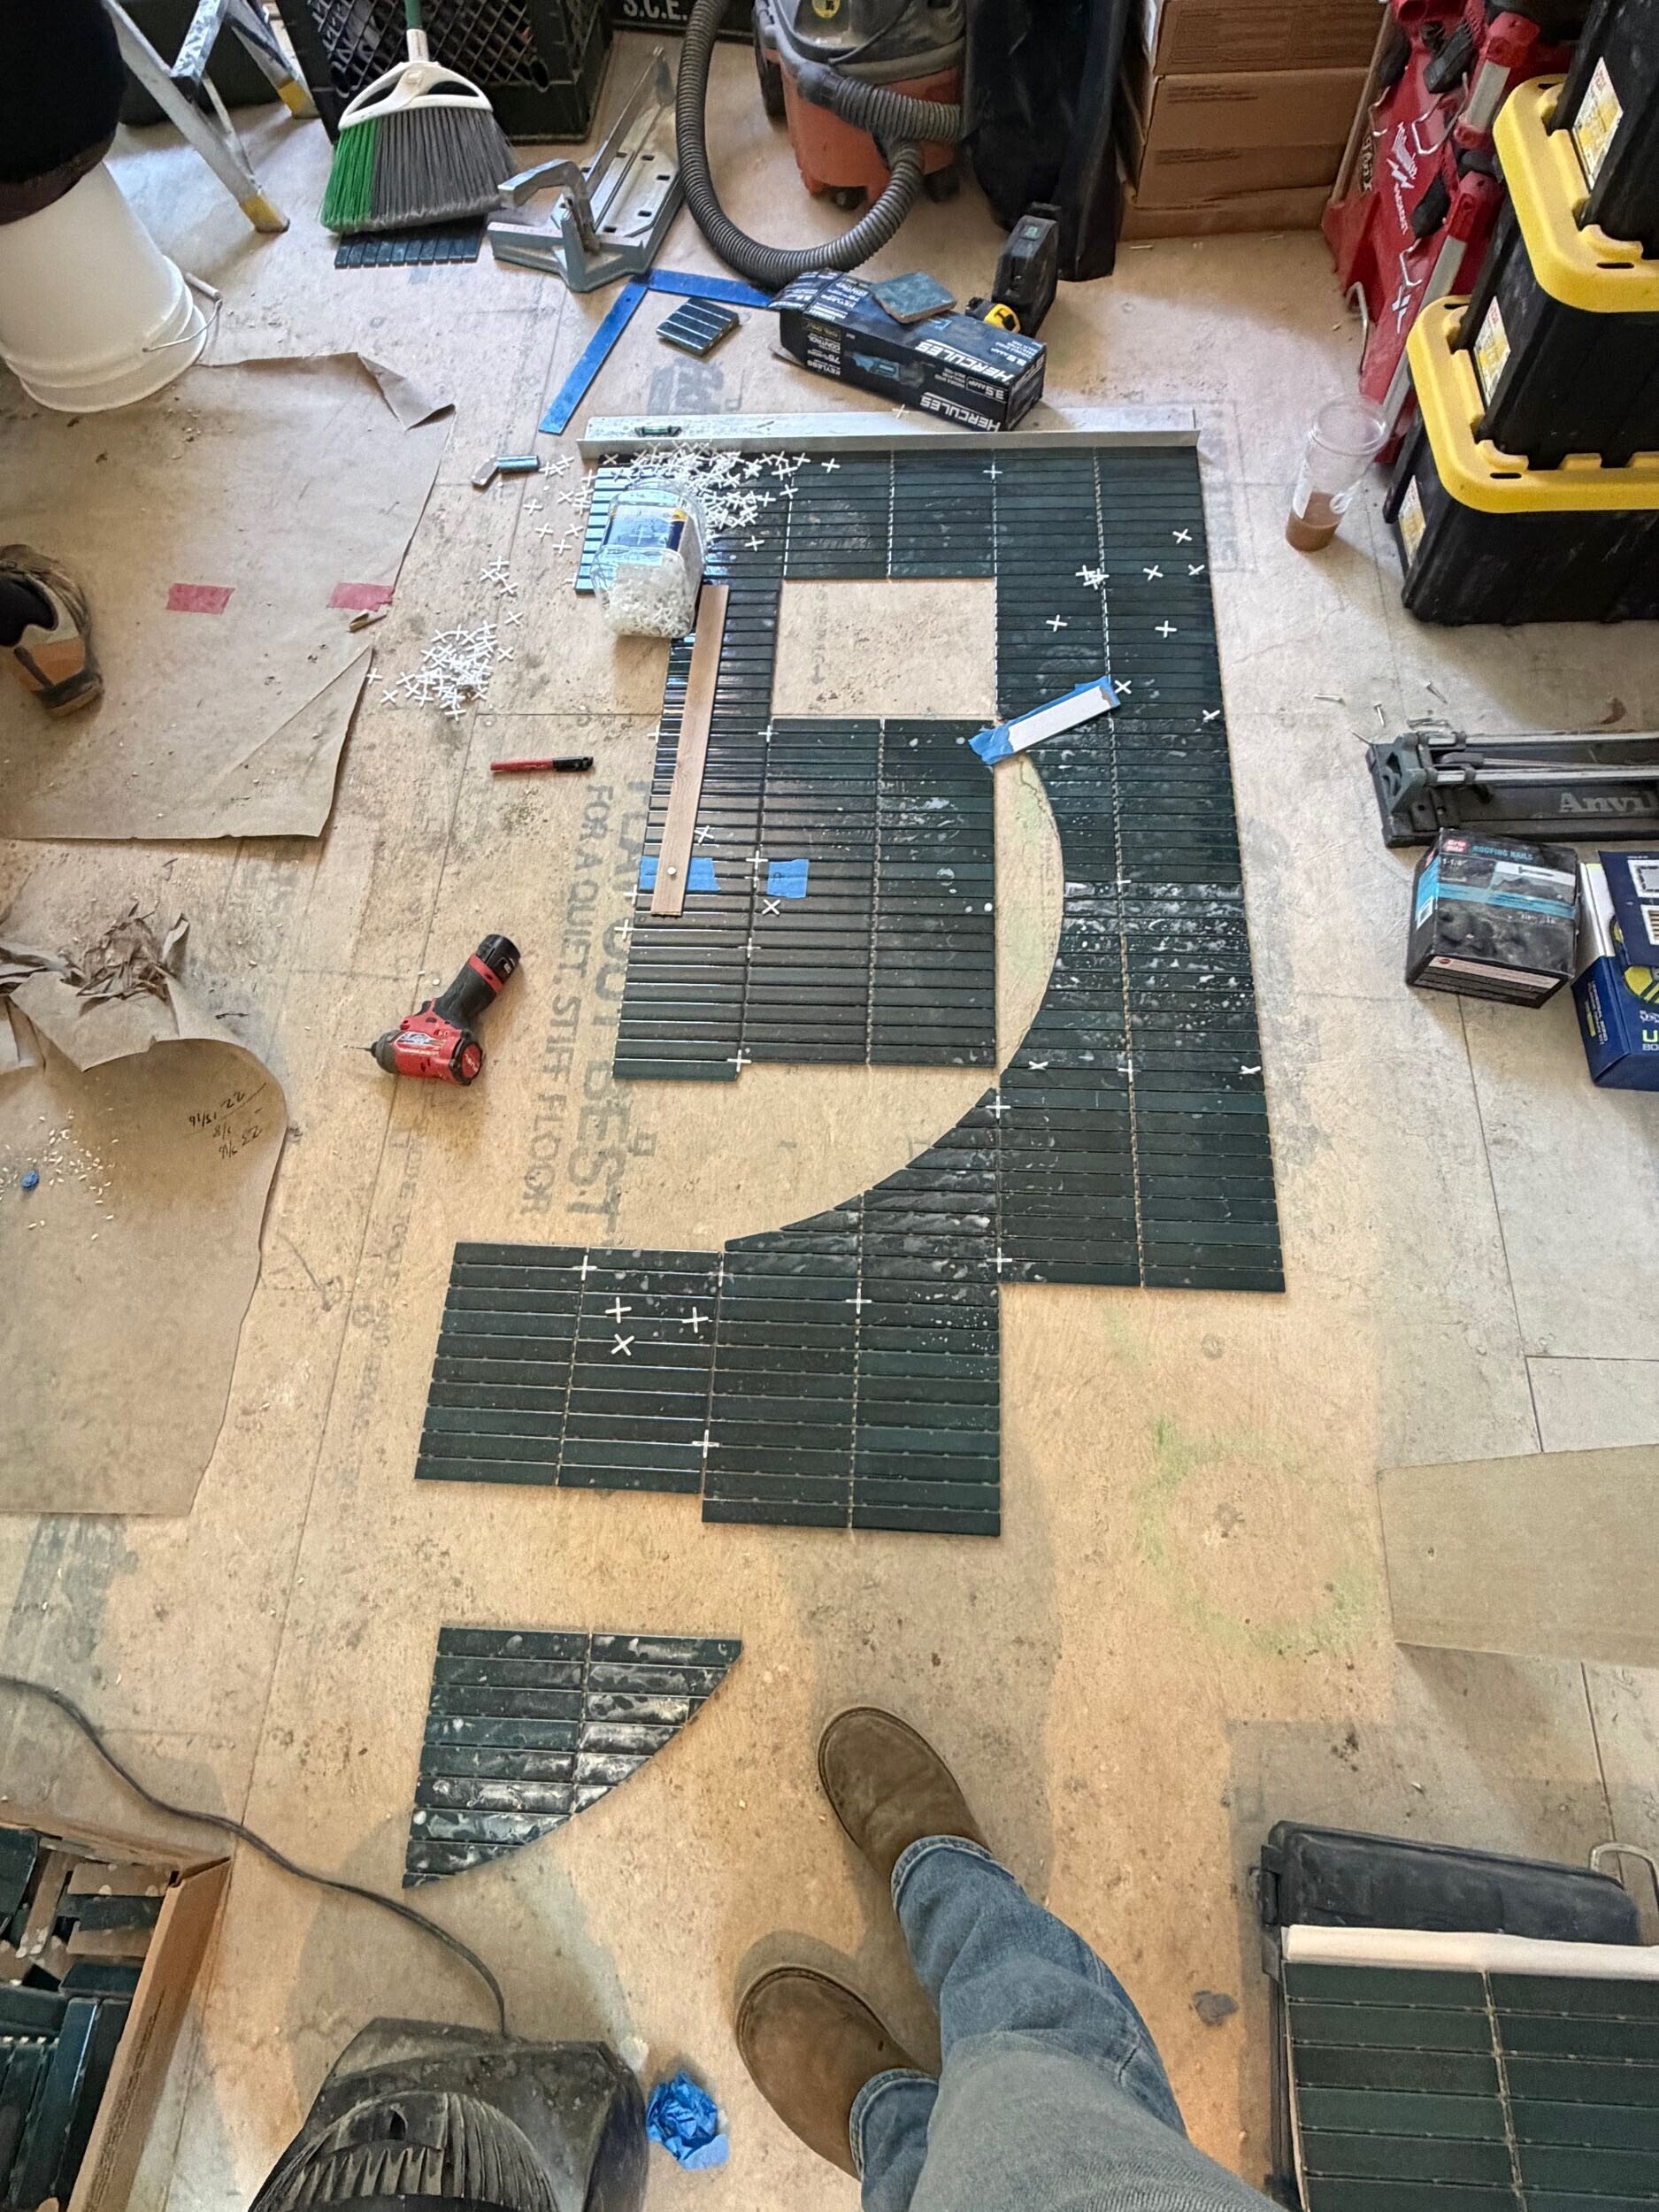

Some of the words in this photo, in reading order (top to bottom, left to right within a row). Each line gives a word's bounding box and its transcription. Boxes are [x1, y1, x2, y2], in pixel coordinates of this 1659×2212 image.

[915, 342, 1015, 382] HERCULES
[984, 386, 1005, 400] 3.5
[920, 396, 1001, 432] HERCULES
[580, 784, 613, 841] FOR
[1557, 791, 1658, 813] Anvil
[574, 847, 603, 872] A
[541, 995, 582, 1083] STIFF
[519, 1093, 567, 1216] FLOOR
[567, 1060, 632, 1233] BEST
